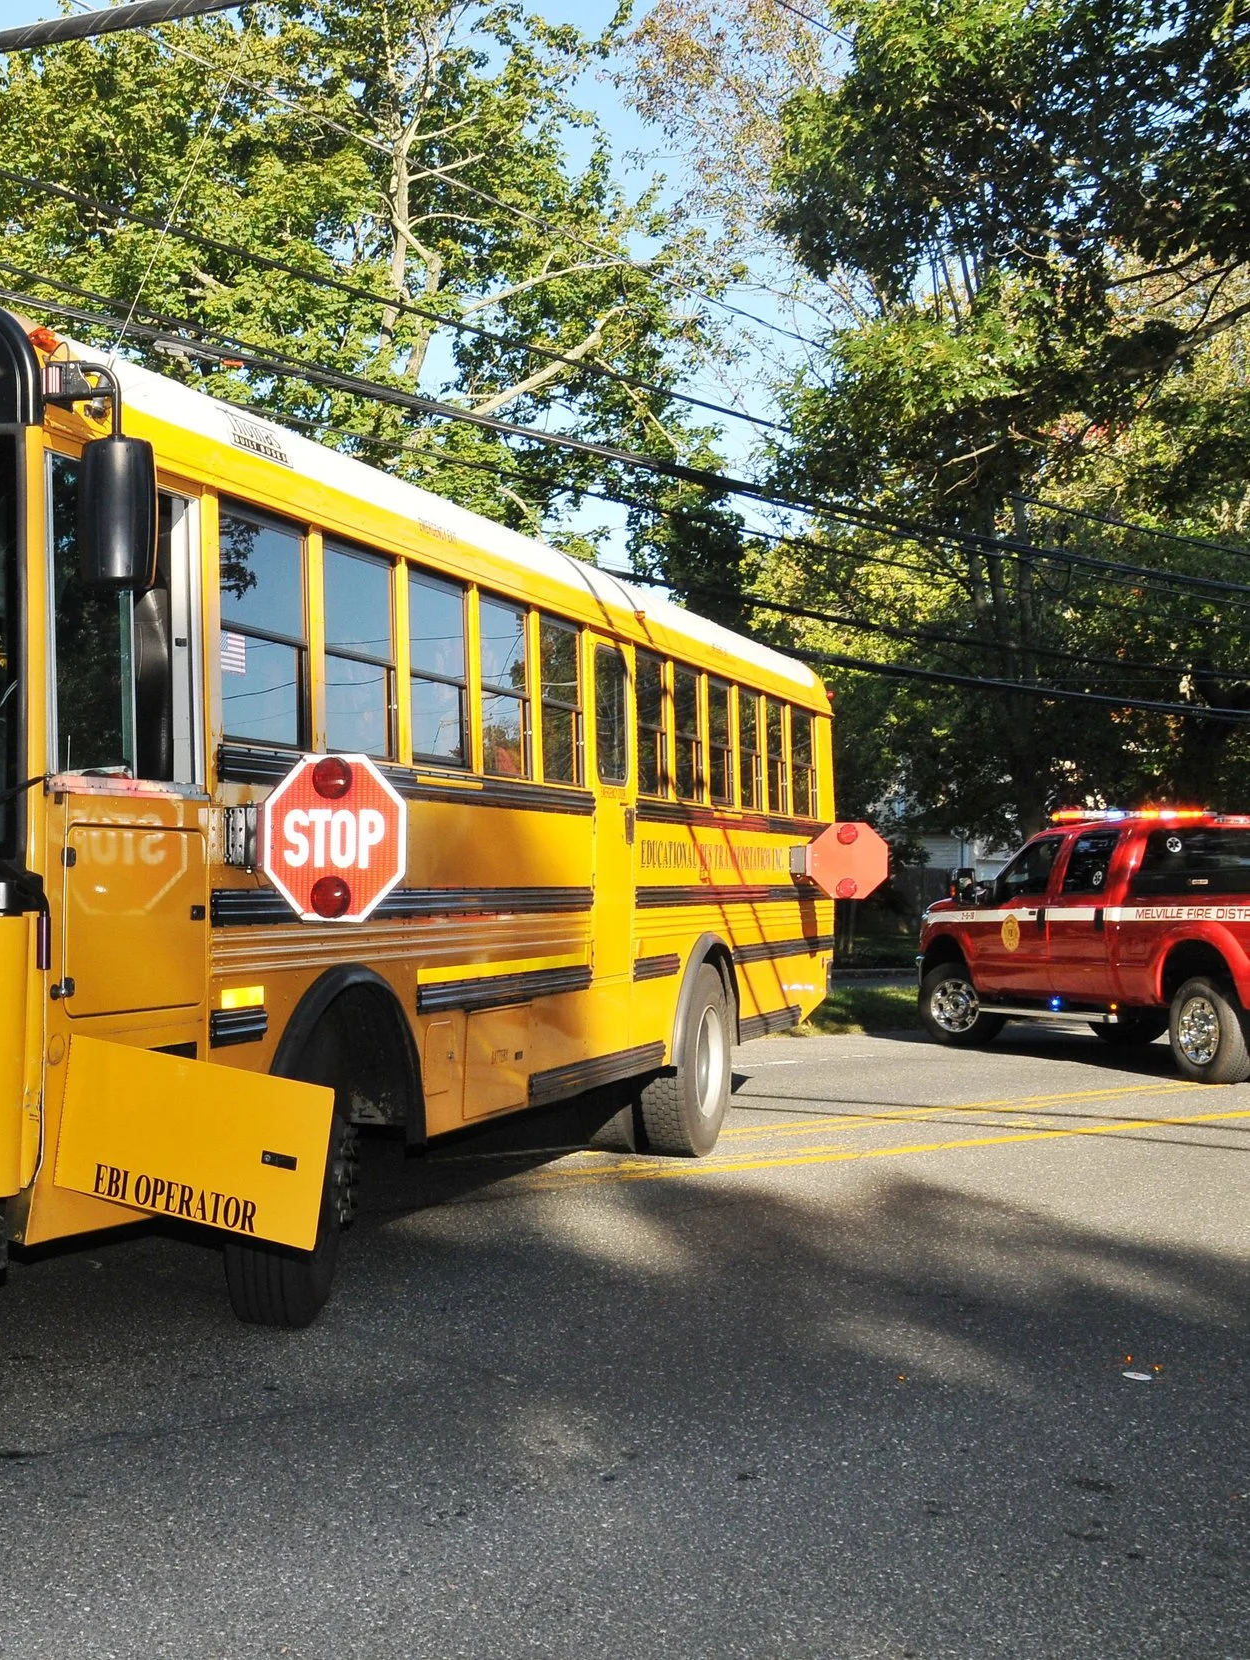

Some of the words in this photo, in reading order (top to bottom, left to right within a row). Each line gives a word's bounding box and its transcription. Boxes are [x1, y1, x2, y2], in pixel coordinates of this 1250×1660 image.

[234, 434, 258, 450] BUILT
[260, 446, 288, 462] BUSES
[283, 809, 385, 869] STOP
[641, 840, 697, 868] EDUCATIONAL
[1135, 908, 1183, 919] MELVILLE
[1187, 908, 1212, 919] FIRE
[93, 1163, 130, 1200] EBI
[134, 1174, 257, 1233] OPERATOR
